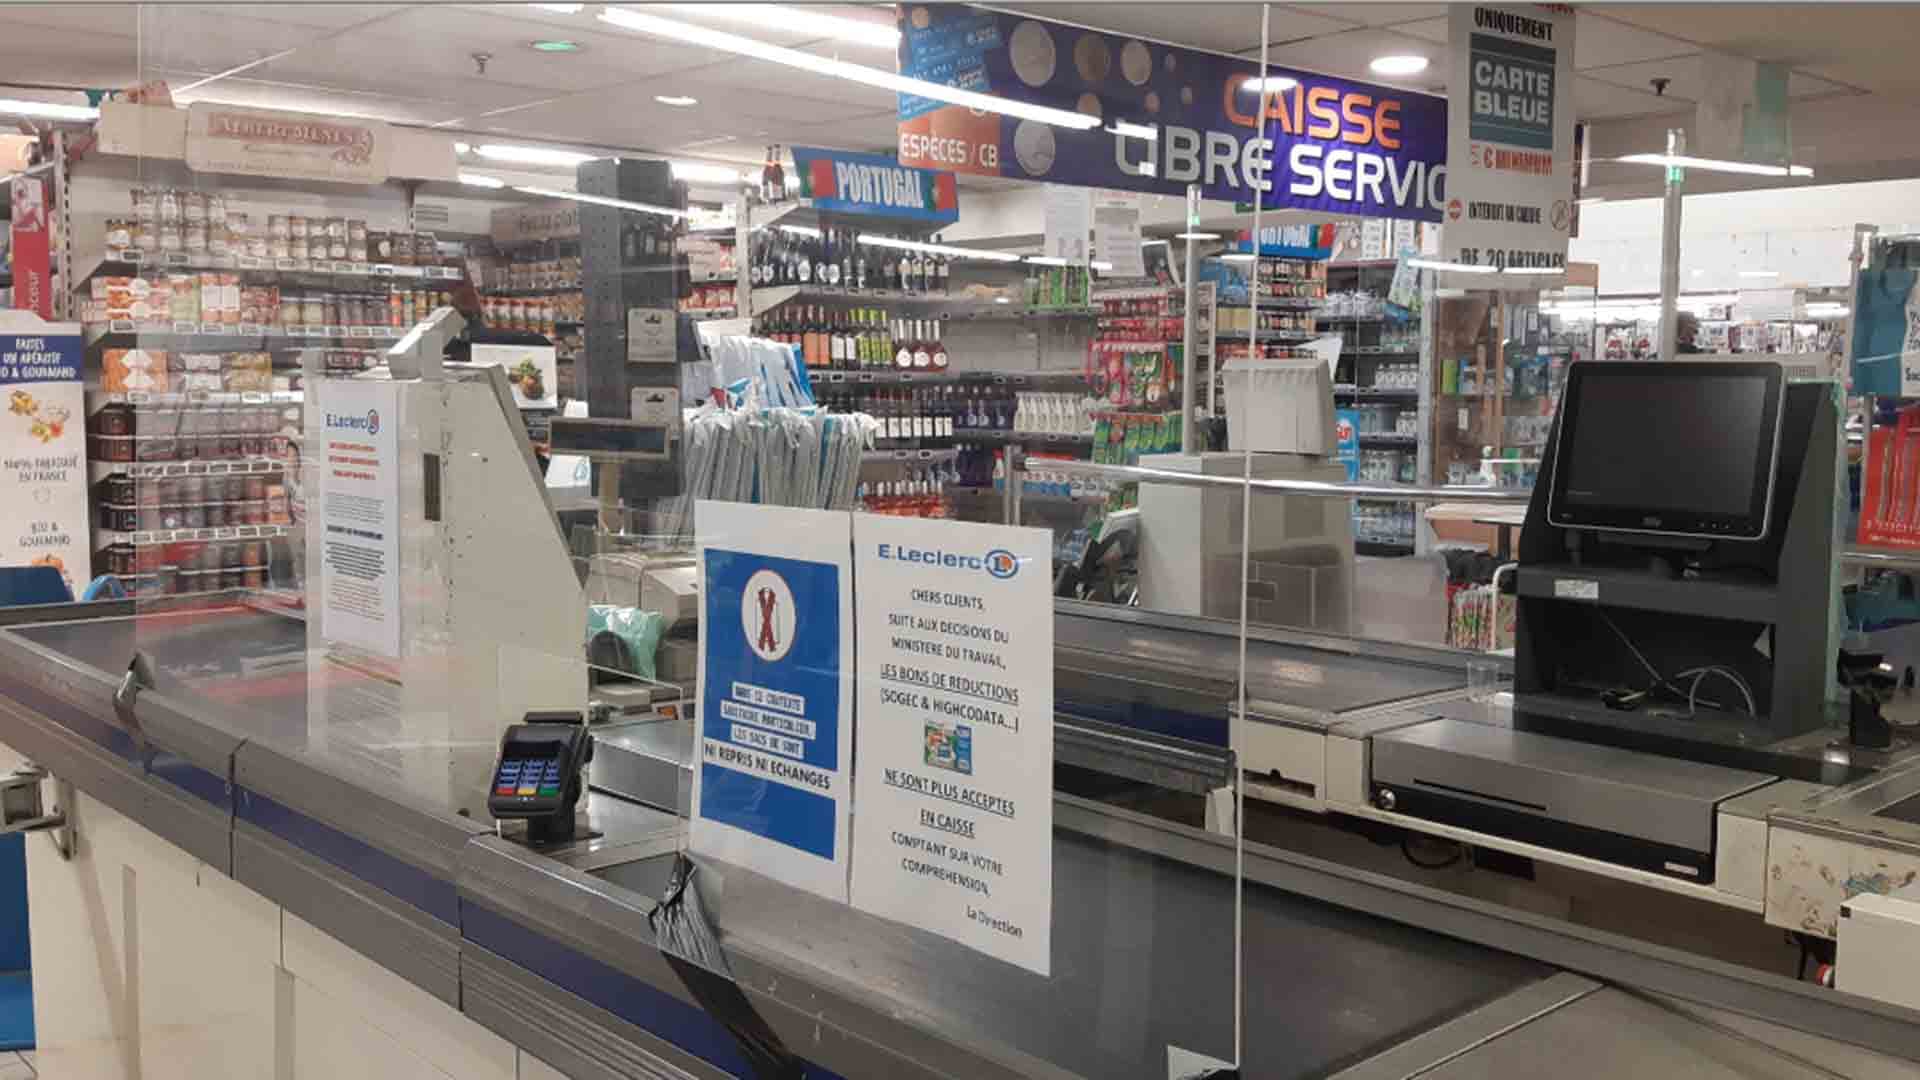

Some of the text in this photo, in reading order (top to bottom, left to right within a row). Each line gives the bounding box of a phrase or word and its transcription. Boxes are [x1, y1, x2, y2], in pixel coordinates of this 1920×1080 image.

[1474, 7, 1553, 41] UNIQUEMENT
[1475, 60, 1550, 97] CARTE
[1223, 73, 1402, 150] CAISSE
[1475, 90, 1550, 126] BLEUE
[1115, 119, 1273, 193] LIBRE
[834, 160, 924, 208] PORTUGAL
[911, 588, 941, 605] CHERS
[888, 613, 1009, 644] SUITE AUX DECISIONS DU
[891, 637, 943, 656] MINISTERE
[945, 645, 960, 659] DU
[880, 663, 1019, 703] LES BONS DE REDUCTIONS
[920, 695, 929, 711] &
[704, 743, 831, 790] NI REPRIS NI ECHANGES
[884, 768, 1015, 816] NE SONT PLUS ACCEPTES
[920, 808, 974, 834] EN CAISSE
[891, 831, 1004, 876] COMPTANT SUR VOTRE
[966, 905, 1023, 940] La Direction
